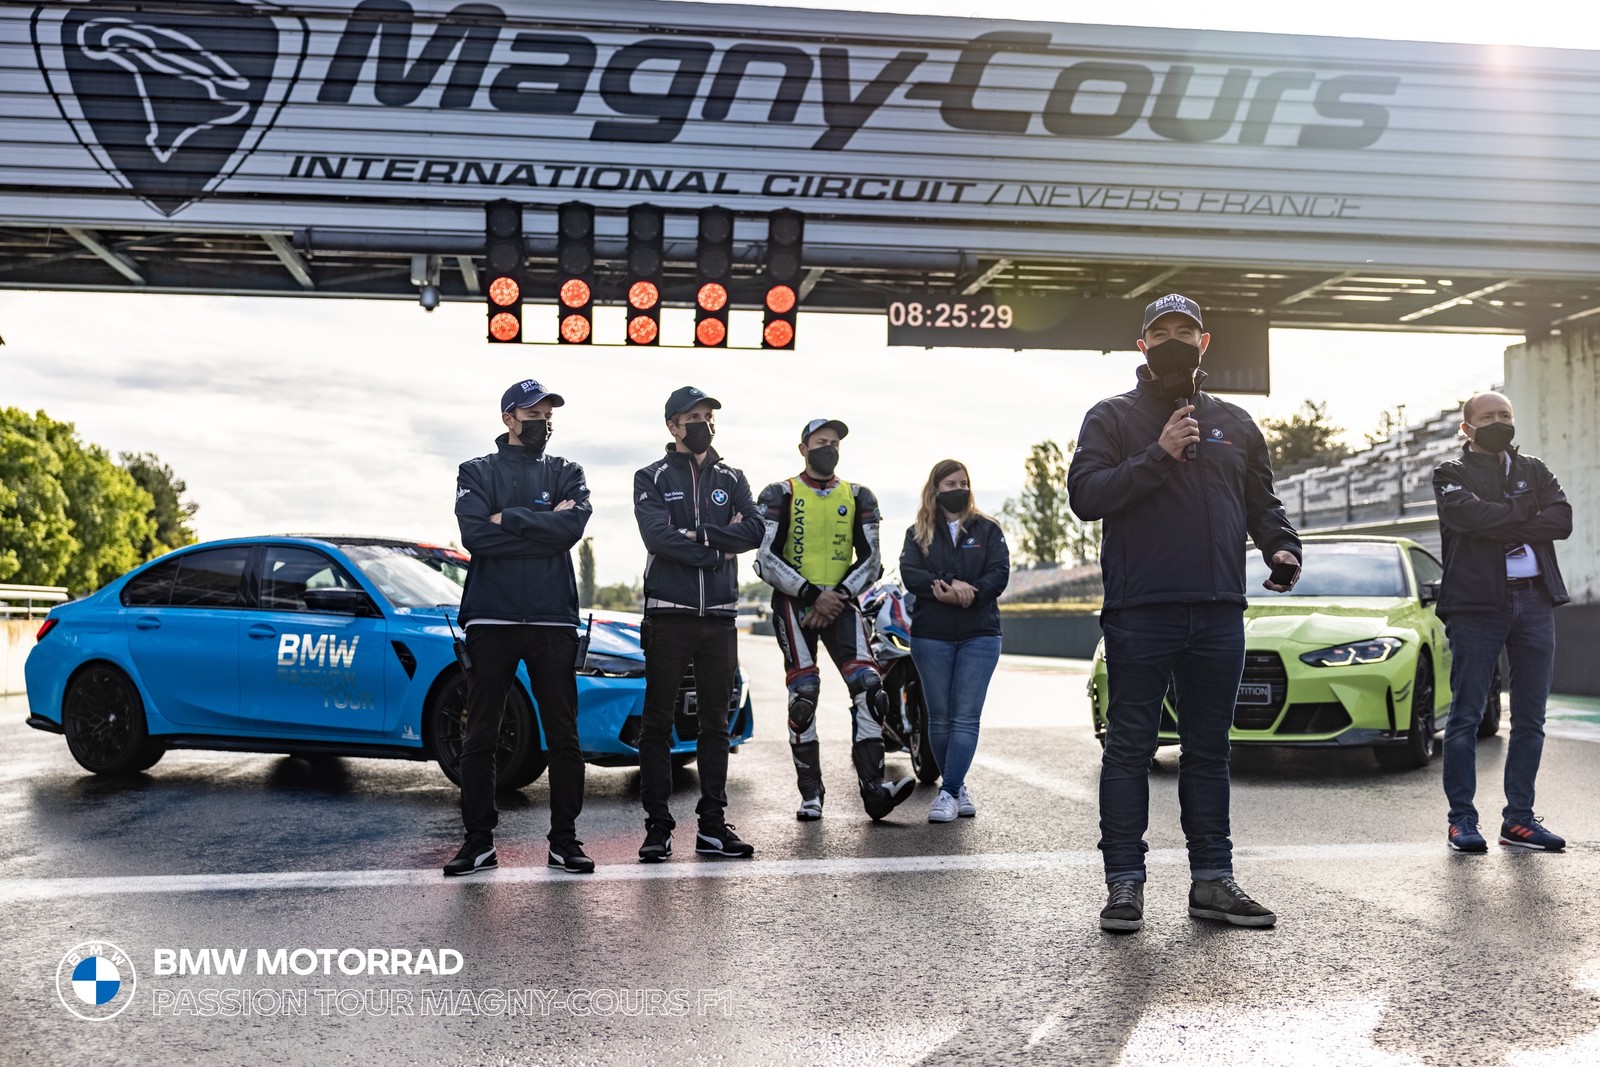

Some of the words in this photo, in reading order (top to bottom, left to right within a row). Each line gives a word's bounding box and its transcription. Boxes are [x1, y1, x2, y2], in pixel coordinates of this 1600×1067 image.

[317, 0, 1400, 150] Magny-Cours
[289, 155, 740, 195] INTERNATIONAL
[761, 174, 977, 203] CIRCUIT
[984, 184, 1004, 206] /
[1014, 184, 1182, 213] NEVERS
[1196, 191, 1361, 219] FRANCE
[889, 302, 1013, 329] 08:25:29
[1156, 295, 1186, 307] BMW
[793, 498, 805, 574] RACKDAYS
[277, 633, 360, 668] BMW
[320, 687, 376, 710] TOUR
